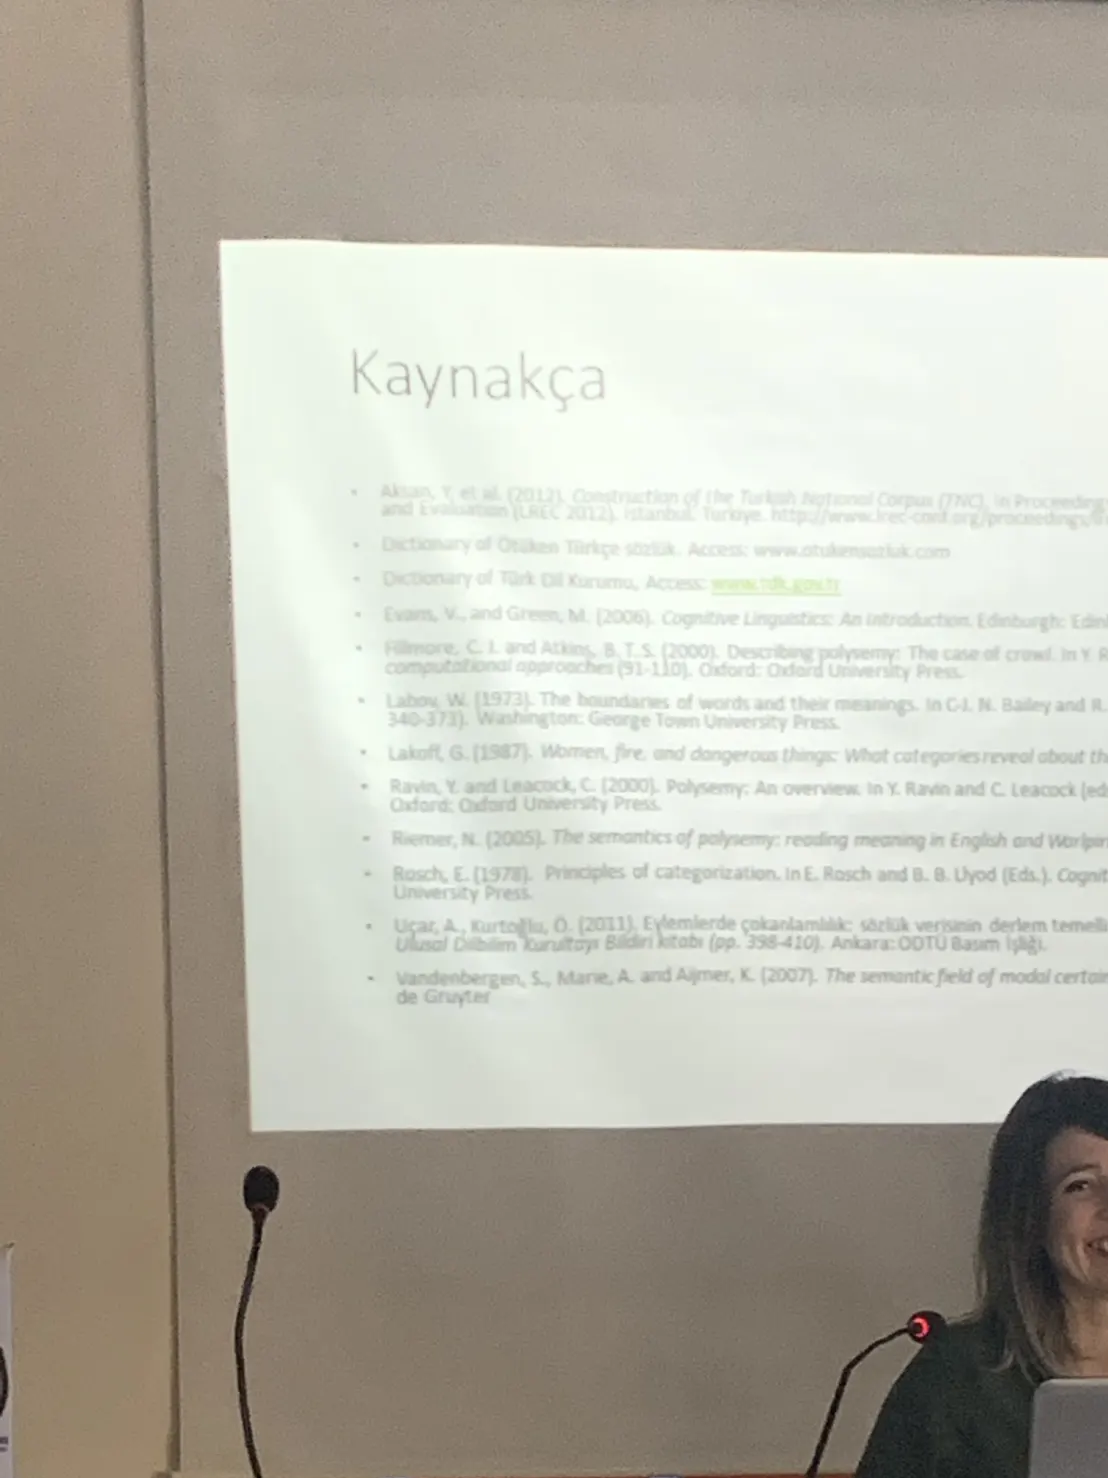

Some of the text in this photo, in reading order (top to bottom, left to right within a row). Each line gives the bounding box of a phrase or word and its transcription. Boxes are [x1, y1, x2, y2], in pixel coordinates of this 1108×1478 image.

[352, 347, 605, 414] Kaynakça
[587, 711, 652, 732] George
[703, 712, 788, 733] University
[689, 746, 779, 766] dangerous
[844, 747, 890, 763] What
[893, 747, 980, 767] categories
[1037, 748, 1085, 764] about
[523, 796, 608, 816] University
[553, 830, 585, 846] The
[588, 830, 673, 847] semantics
[853, 831, 927, 851] meaning
[949, 831, 1008, 851] English
[545, 865, 626, 884] Principles
[394, 884, 480, 903] University
[827, 969, 856, 985] The
[860, 969, 934, 985] semantic
